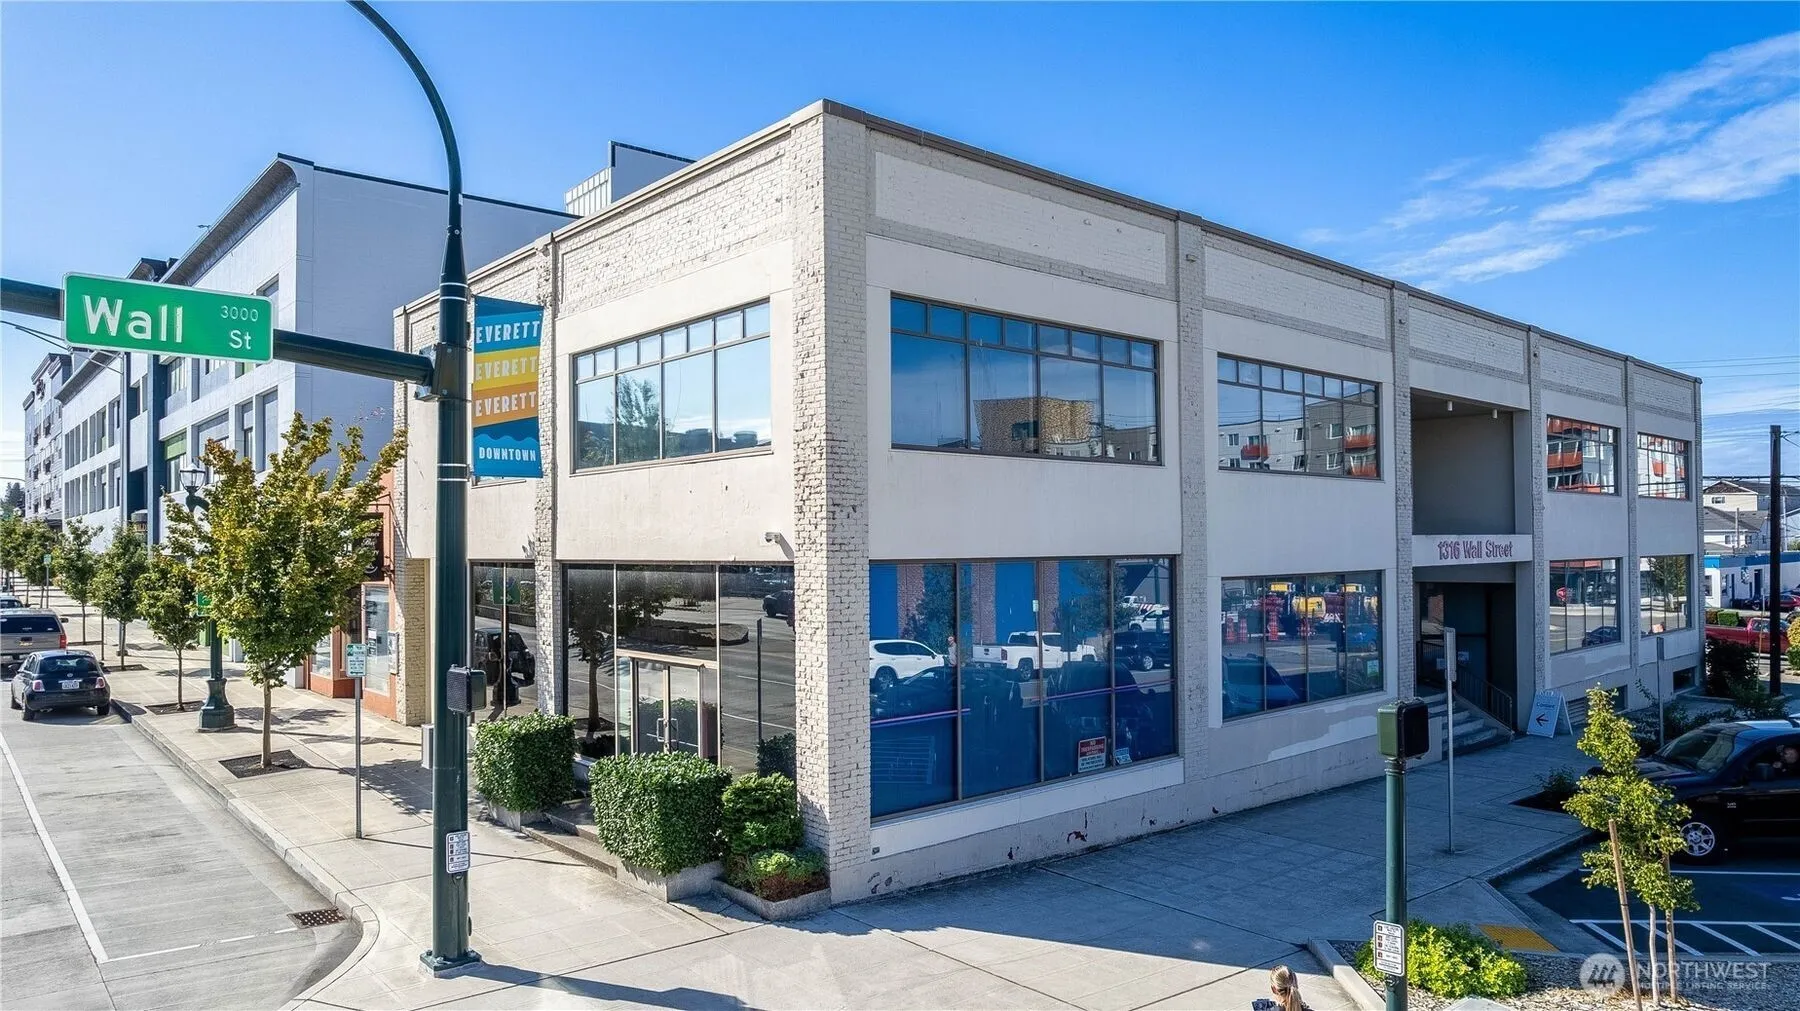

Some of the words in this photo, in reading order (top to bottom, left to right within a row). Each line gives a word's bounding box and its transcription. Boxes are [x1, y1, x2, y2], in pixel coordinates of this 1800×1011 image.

[82, 294, 183, 343] Wall
[229, 330, 252, 350] St
[220, 305, 259, 322] 3000
[476, 321, 540, 344] EVERETT
[475, 355, 538, 381] EVERETT
[475, 391, 537, 417] EVERETT
[479, 447, 537, 462] DOWNTOWN
[1437, 541, 1460, 560] 1316
[1462, 541, 1482, 558] Wall
[1485, 540, 1513, 558] Street
